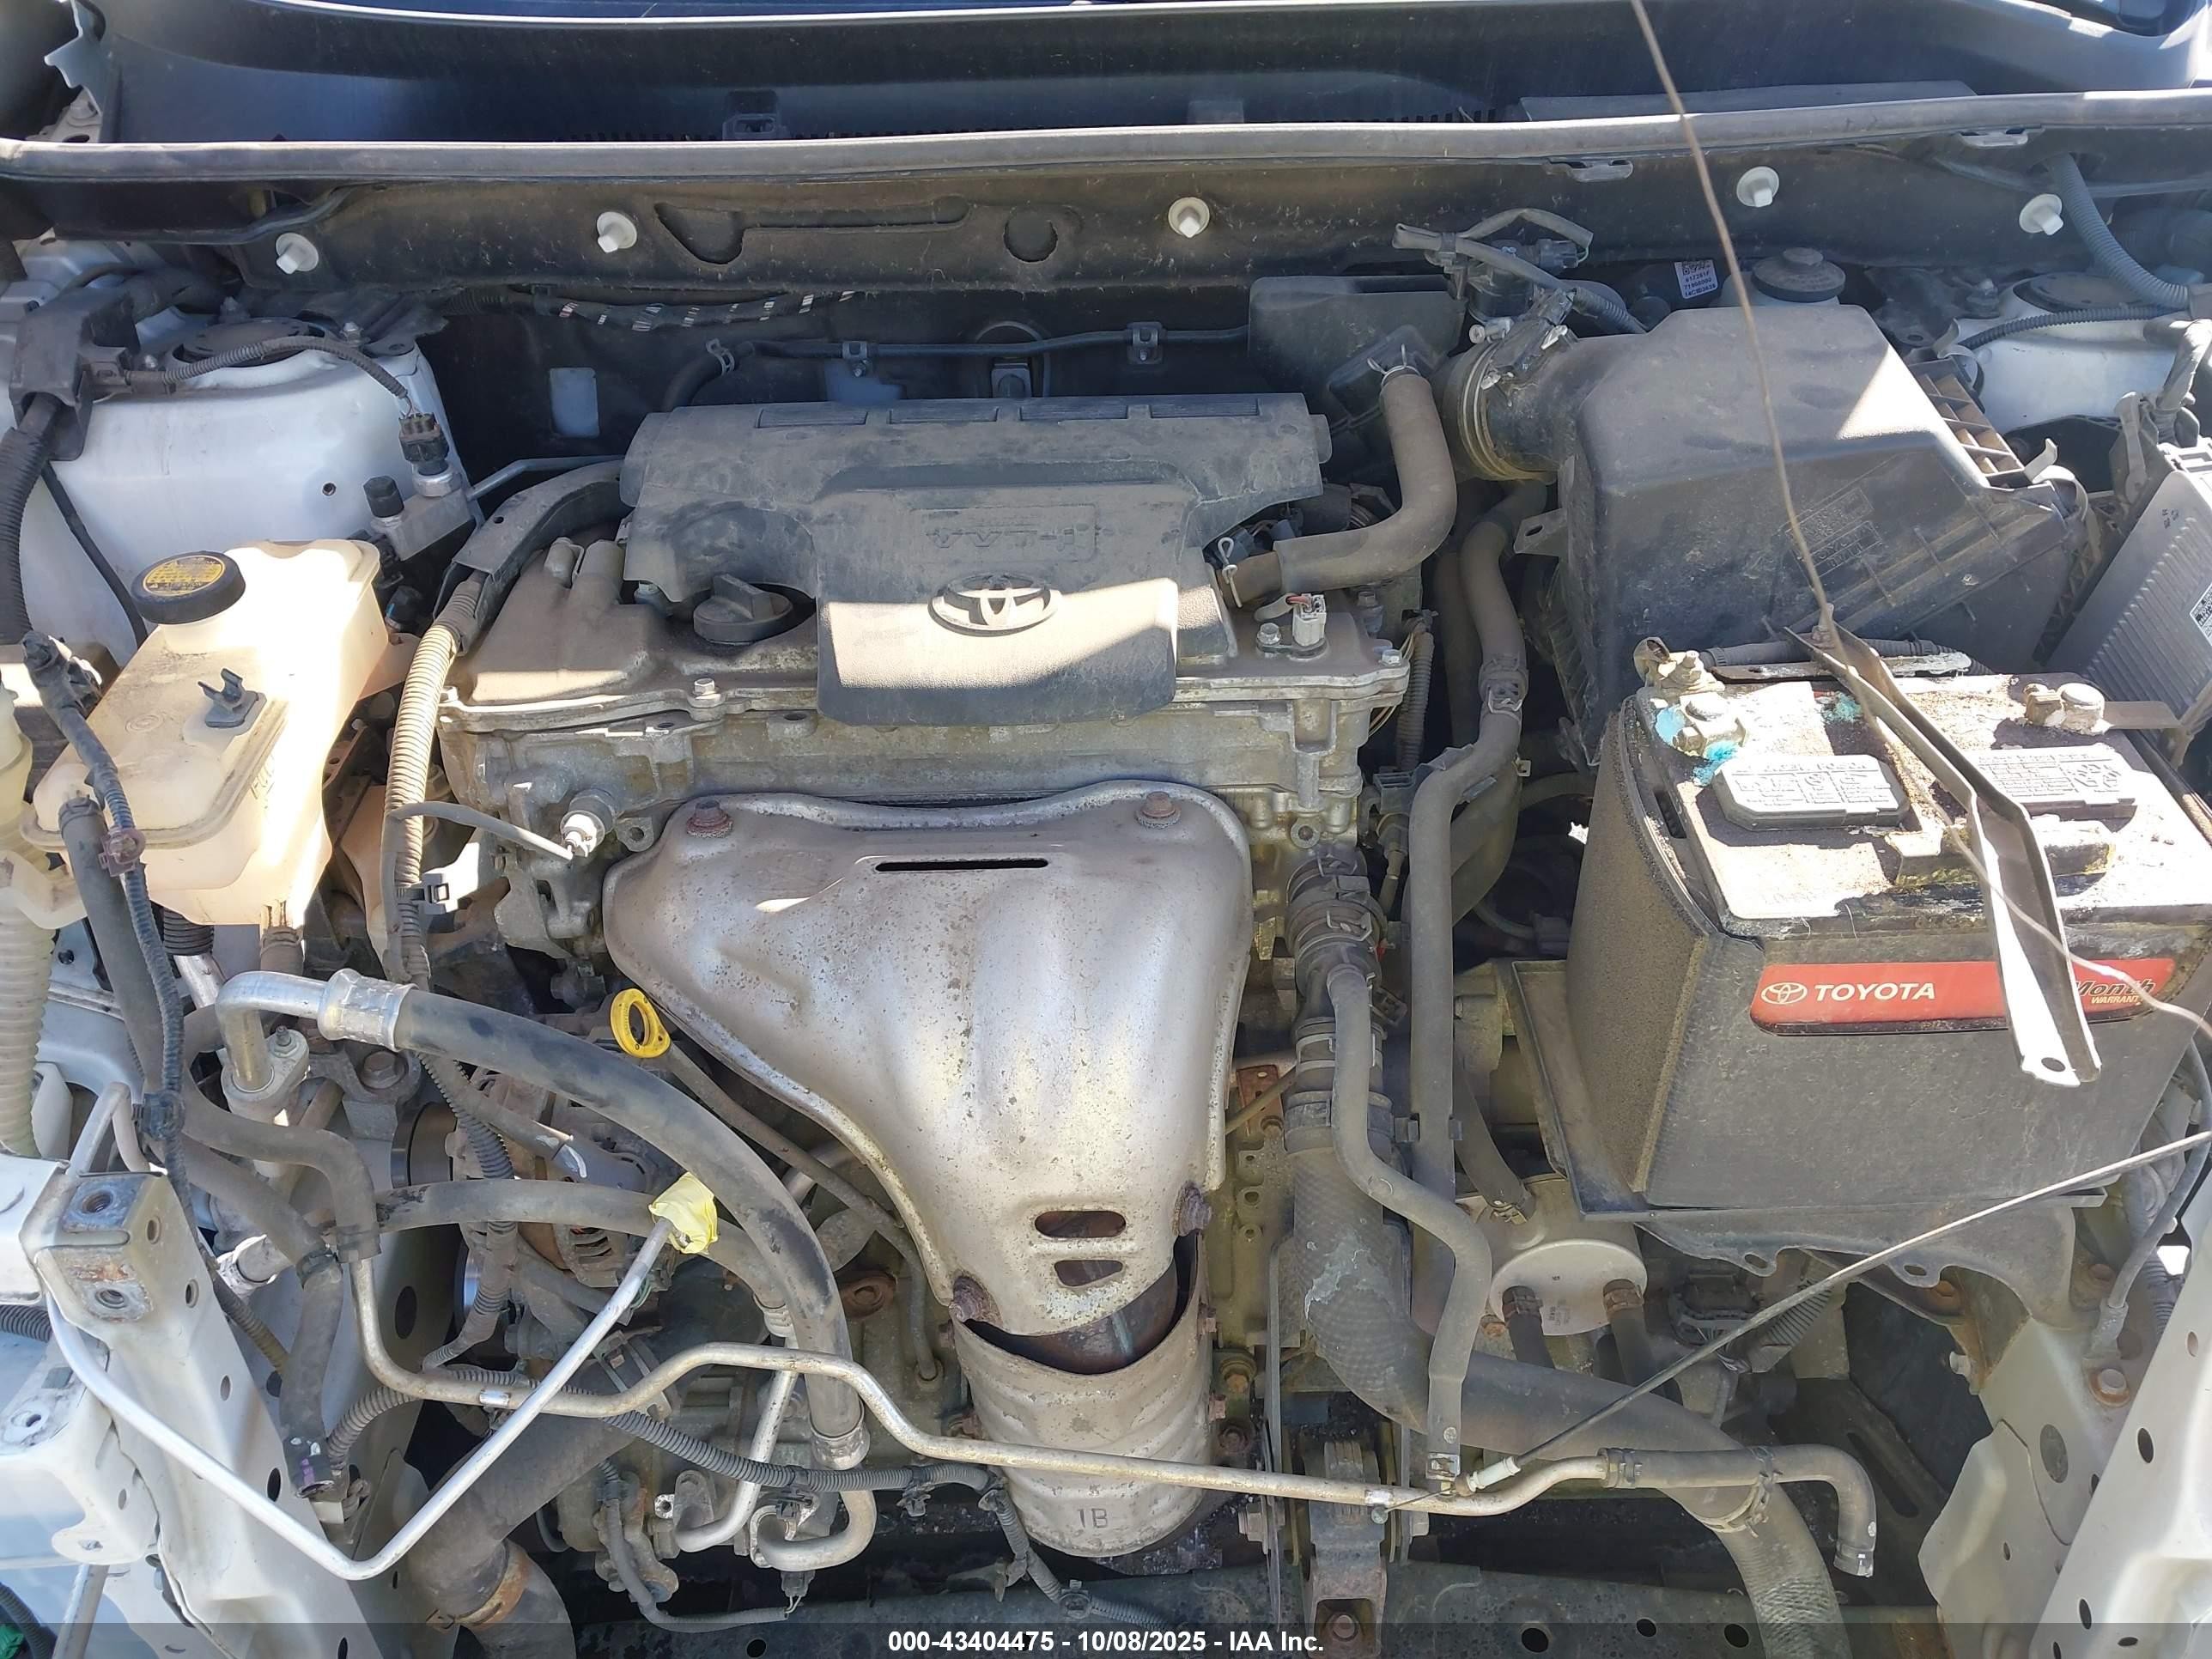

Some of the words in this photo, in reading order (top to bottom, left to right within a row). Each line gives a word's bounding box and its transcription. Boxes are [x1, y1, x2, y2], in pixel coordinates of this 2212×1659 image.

[1814, 982, 1936, 1001] TOYOTA
[2091, 995, 2143, 1006] WARRANT
[1077, 1508, 1108, 1528] 1B
